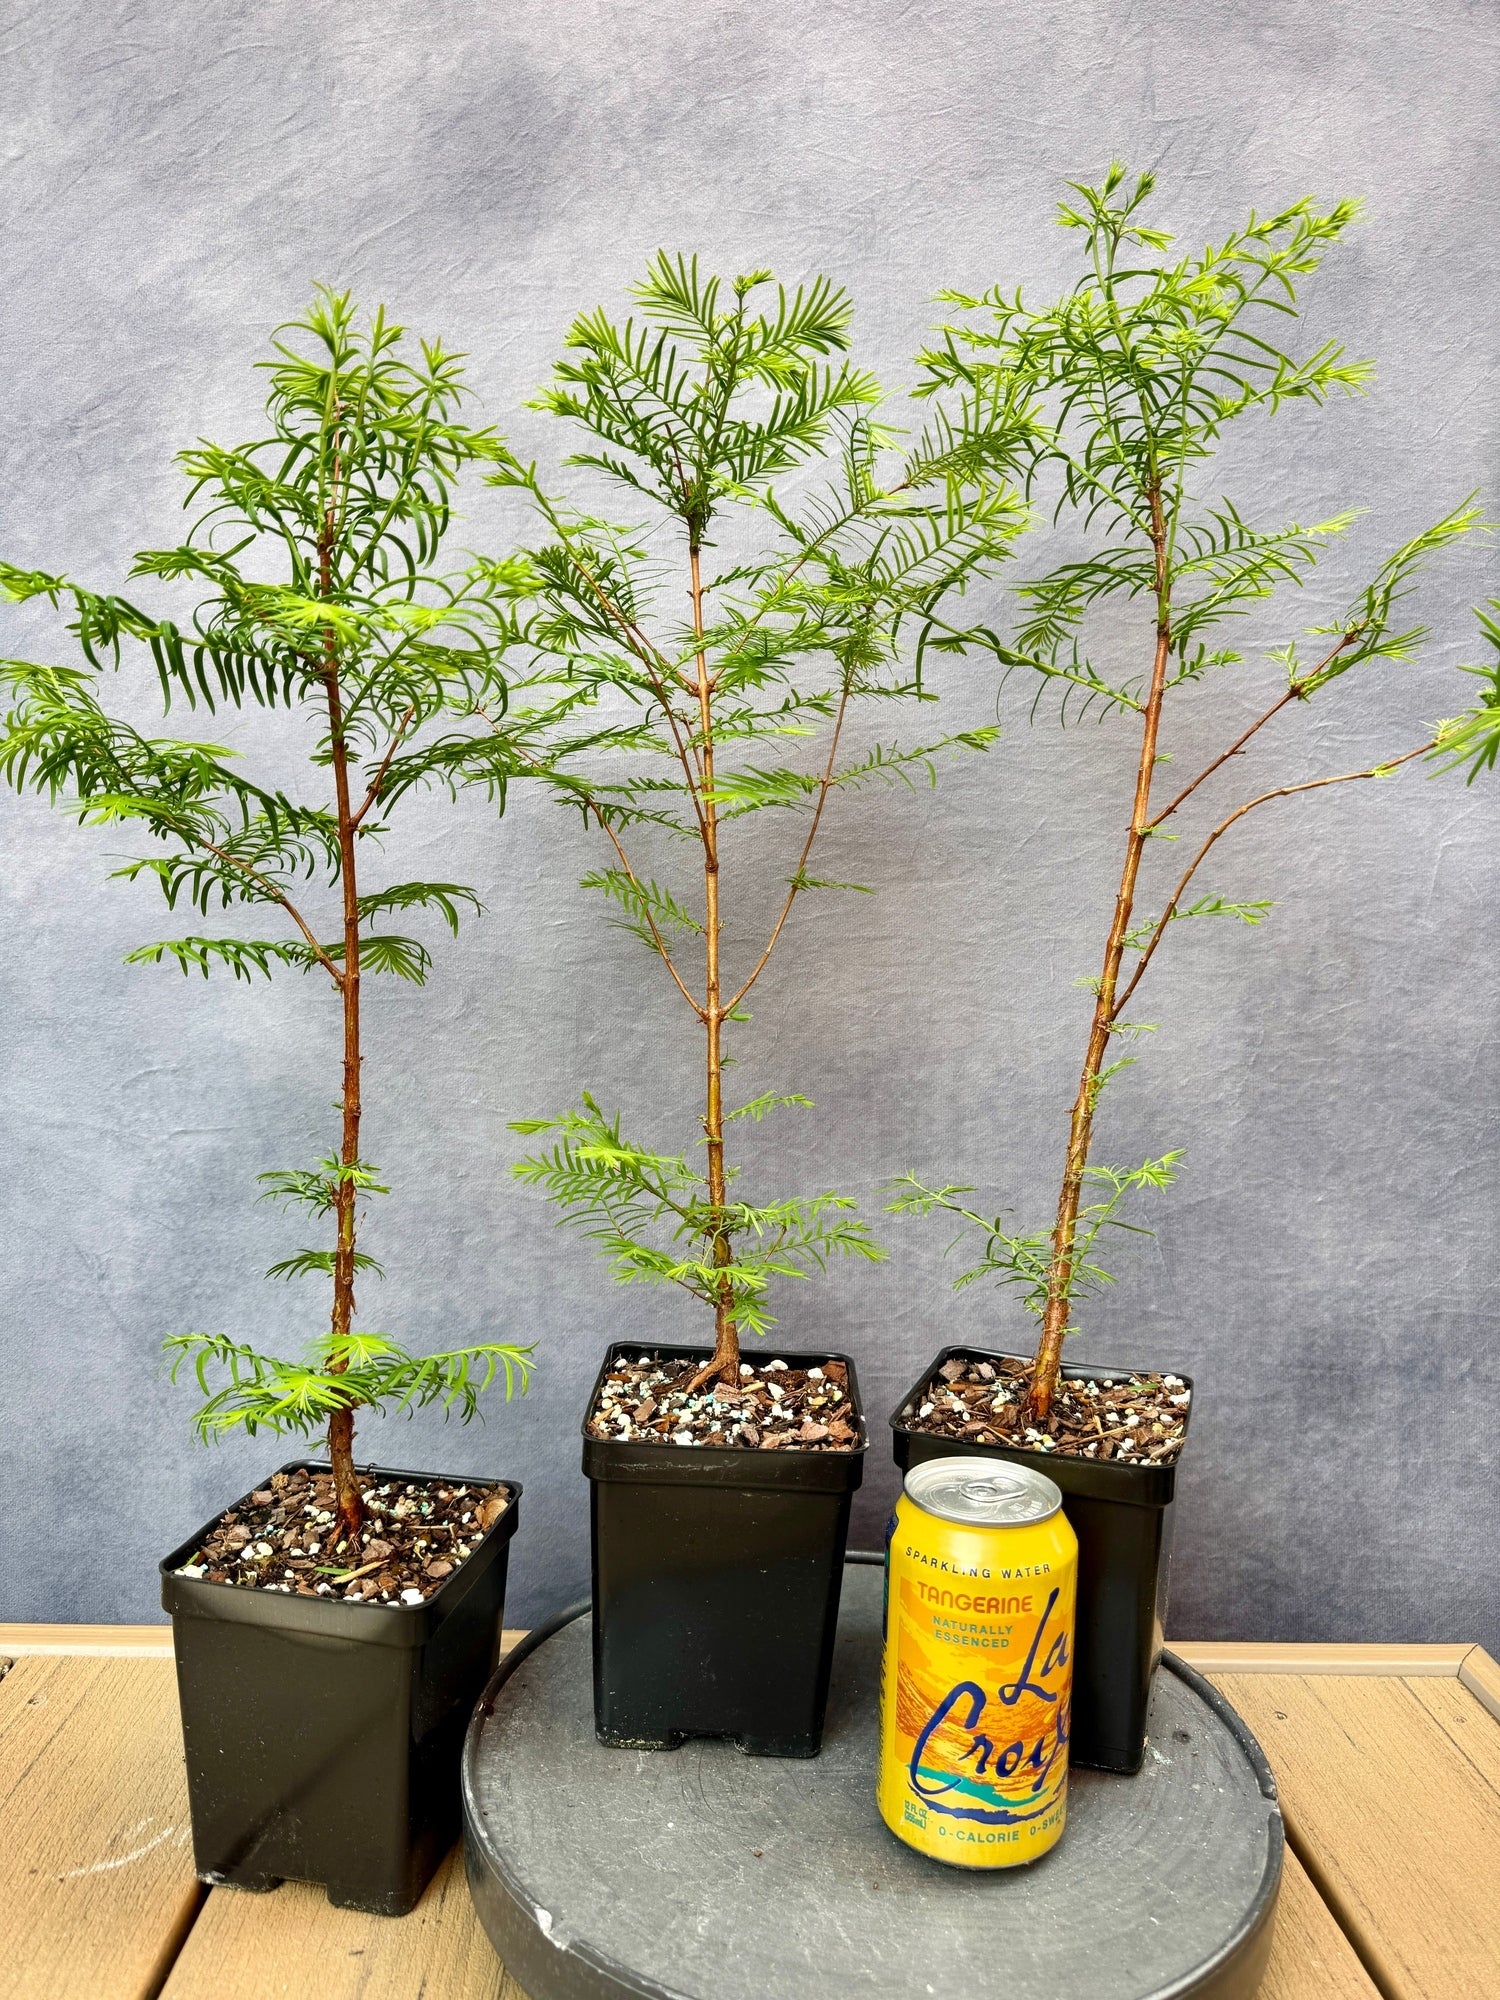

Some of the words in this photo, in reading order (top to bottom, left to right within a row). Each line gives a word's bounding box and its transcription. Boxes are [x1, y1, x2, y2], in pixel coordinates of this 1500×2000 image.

[905, 1546, 991, 1579] SPARKLING
[1001, 1563, 1051, 1579] WATER
[917, 1581, 1033, 1614] TANGERINE
[932, 1615, 1013, 1635] NATURALLY
[935, 1629, 1010, 1649] ESSENCED
[998, 1587, 1069, 1705] La
[938, 1823, 1020, 1843] 0-CALORIE
